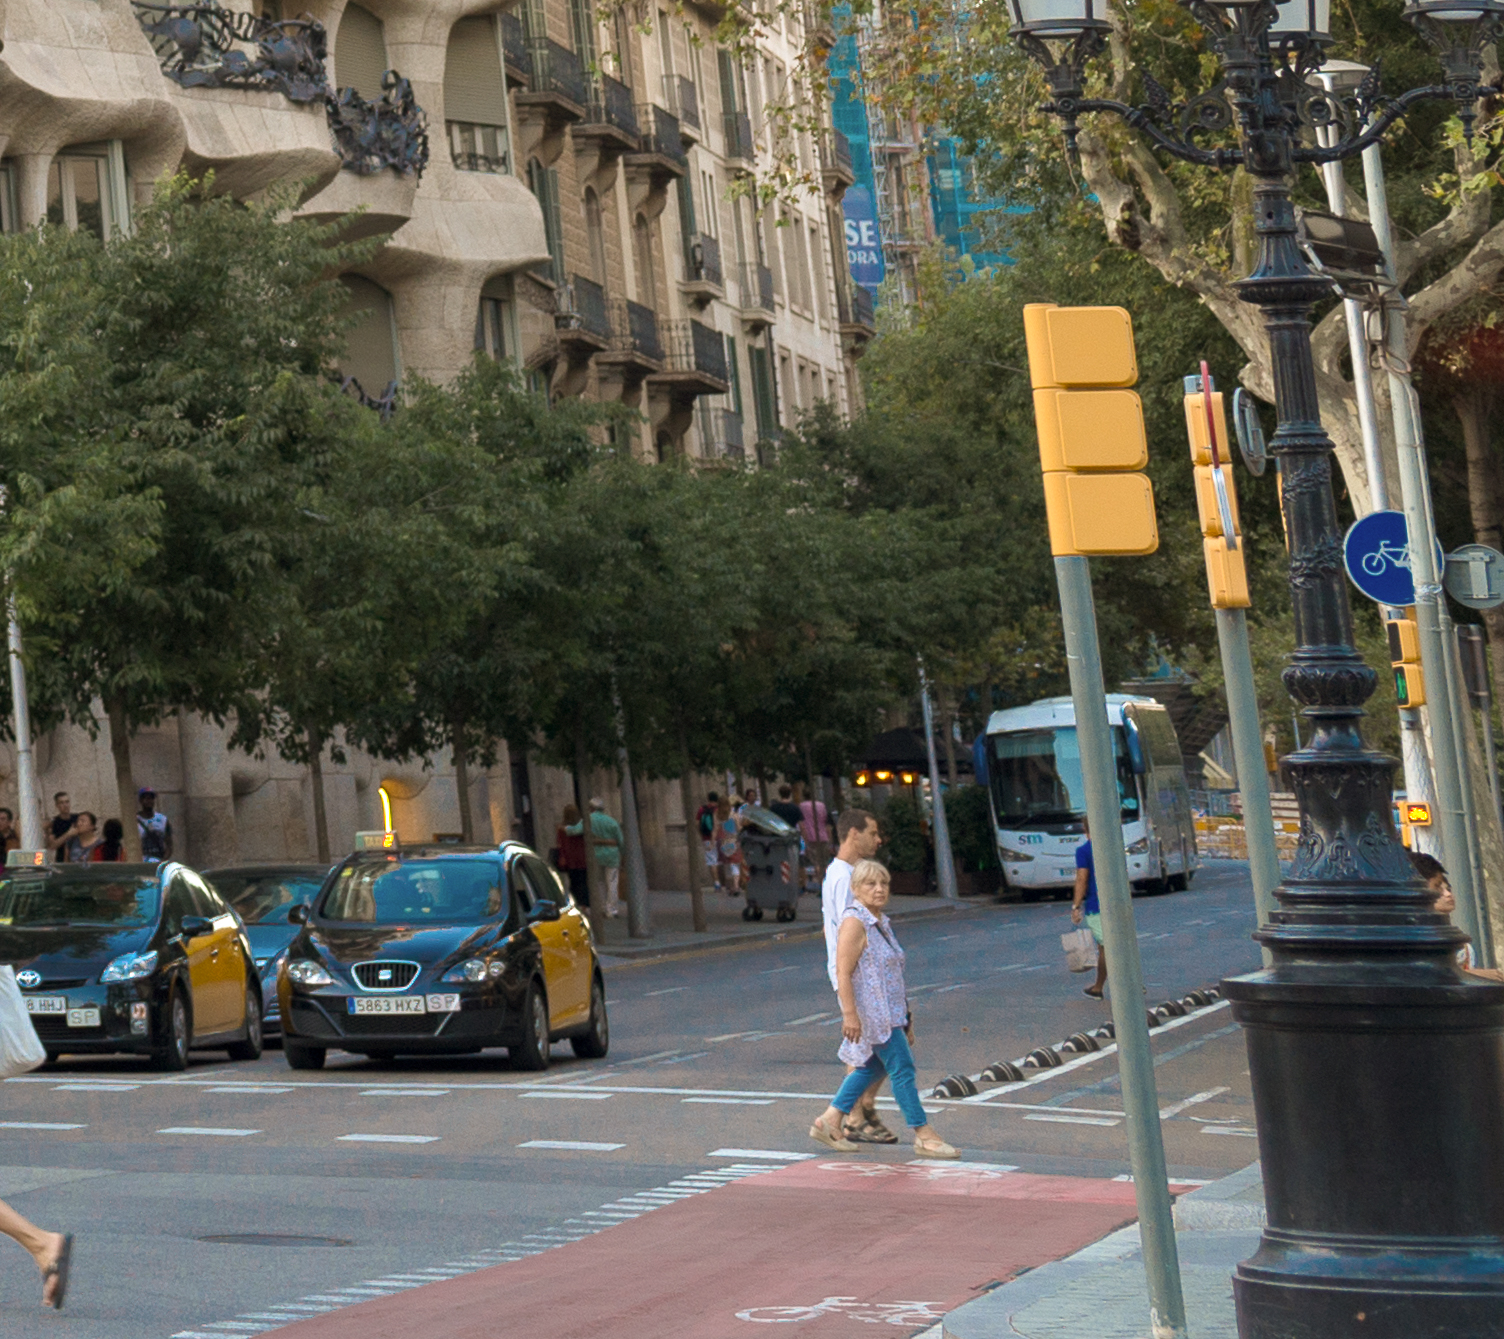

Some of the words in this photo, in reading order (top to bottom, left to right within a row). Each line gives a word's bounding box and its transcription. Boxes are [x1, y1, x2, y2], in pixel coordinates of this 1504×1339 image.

[39, 1000, 62, 1012] HHJ
[357, 999, 391, 1011] 5863
[395, 998, 422, 1011] HXZ
[429, 996, 455, 1009] SP
[70, 1011, 96, 1024] SP
